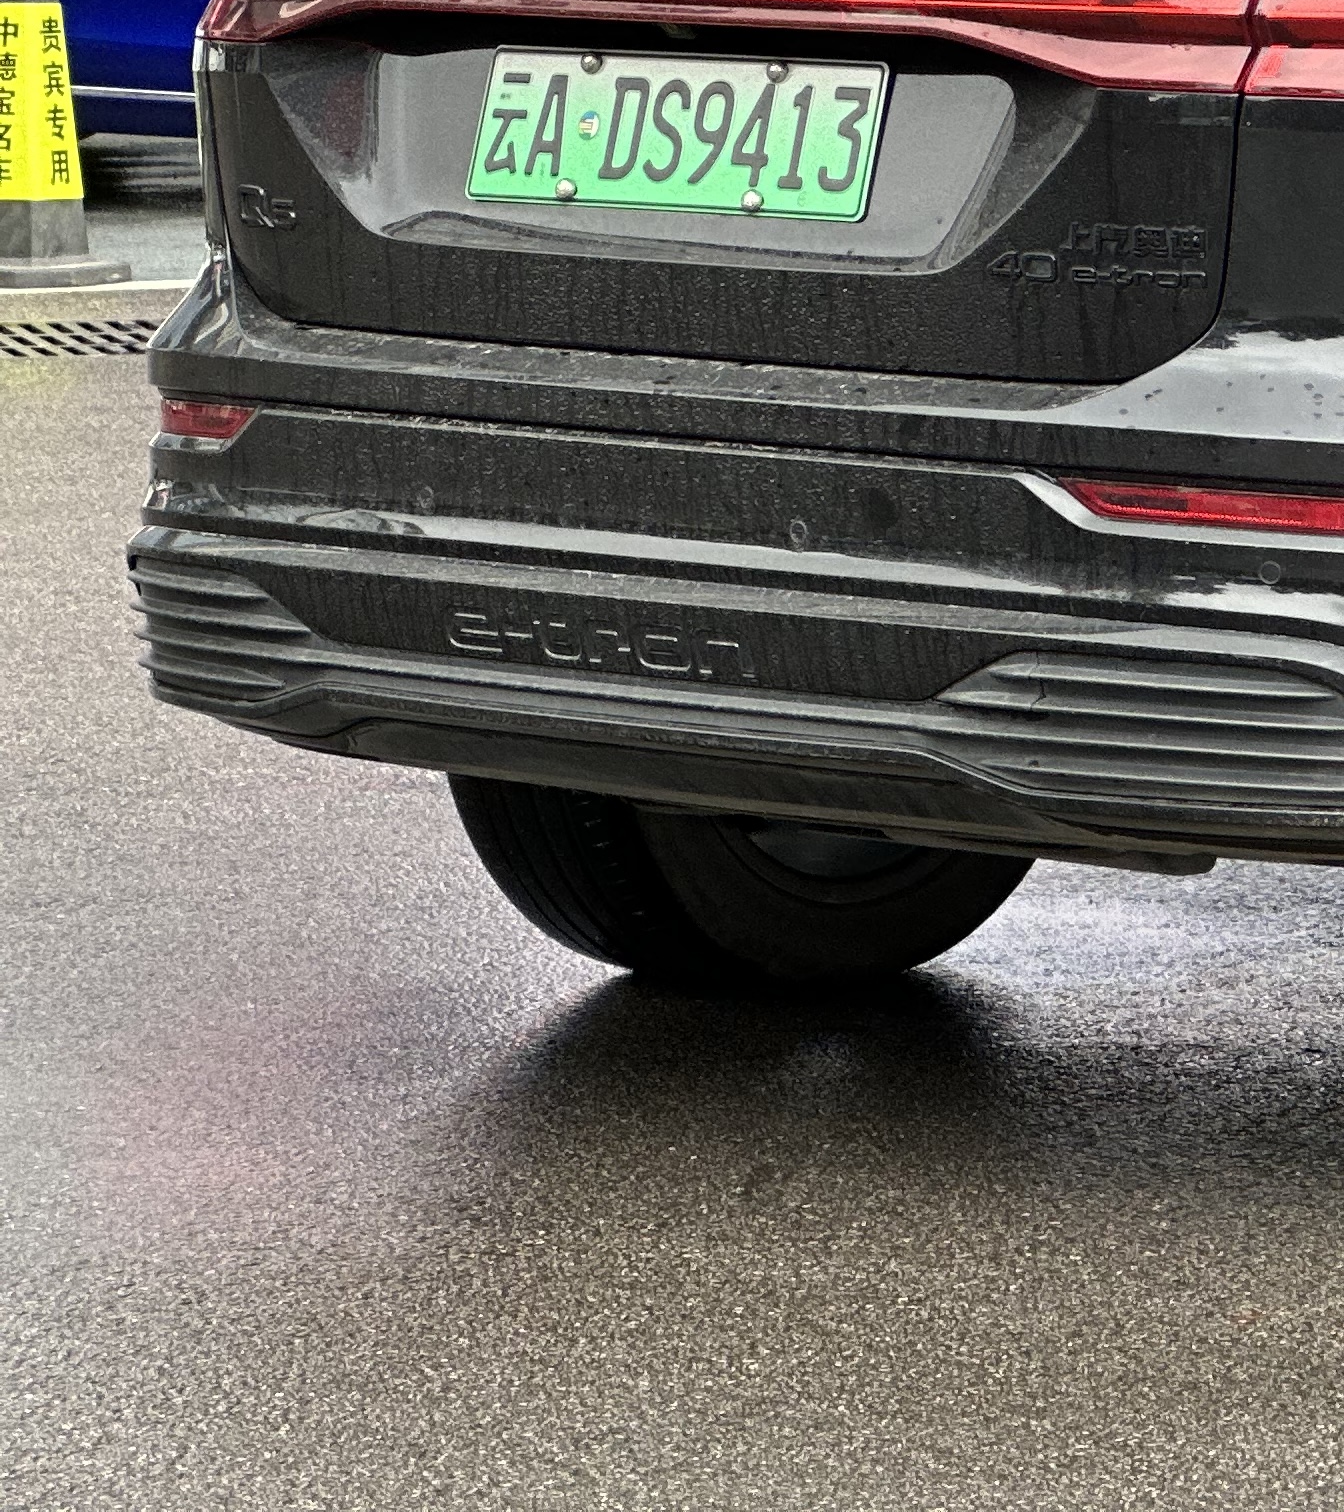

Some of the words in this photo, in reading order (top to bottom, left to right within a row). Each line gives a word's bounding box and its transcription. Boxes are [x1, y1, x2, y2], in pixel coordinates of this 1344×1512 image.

[39, 15, 70, 186] 贵宾专用
[987, 250, 1058, 283] 40
[1072, 264, 1208, 289] e-tron
[449, 602, 756, 681] e-tron
